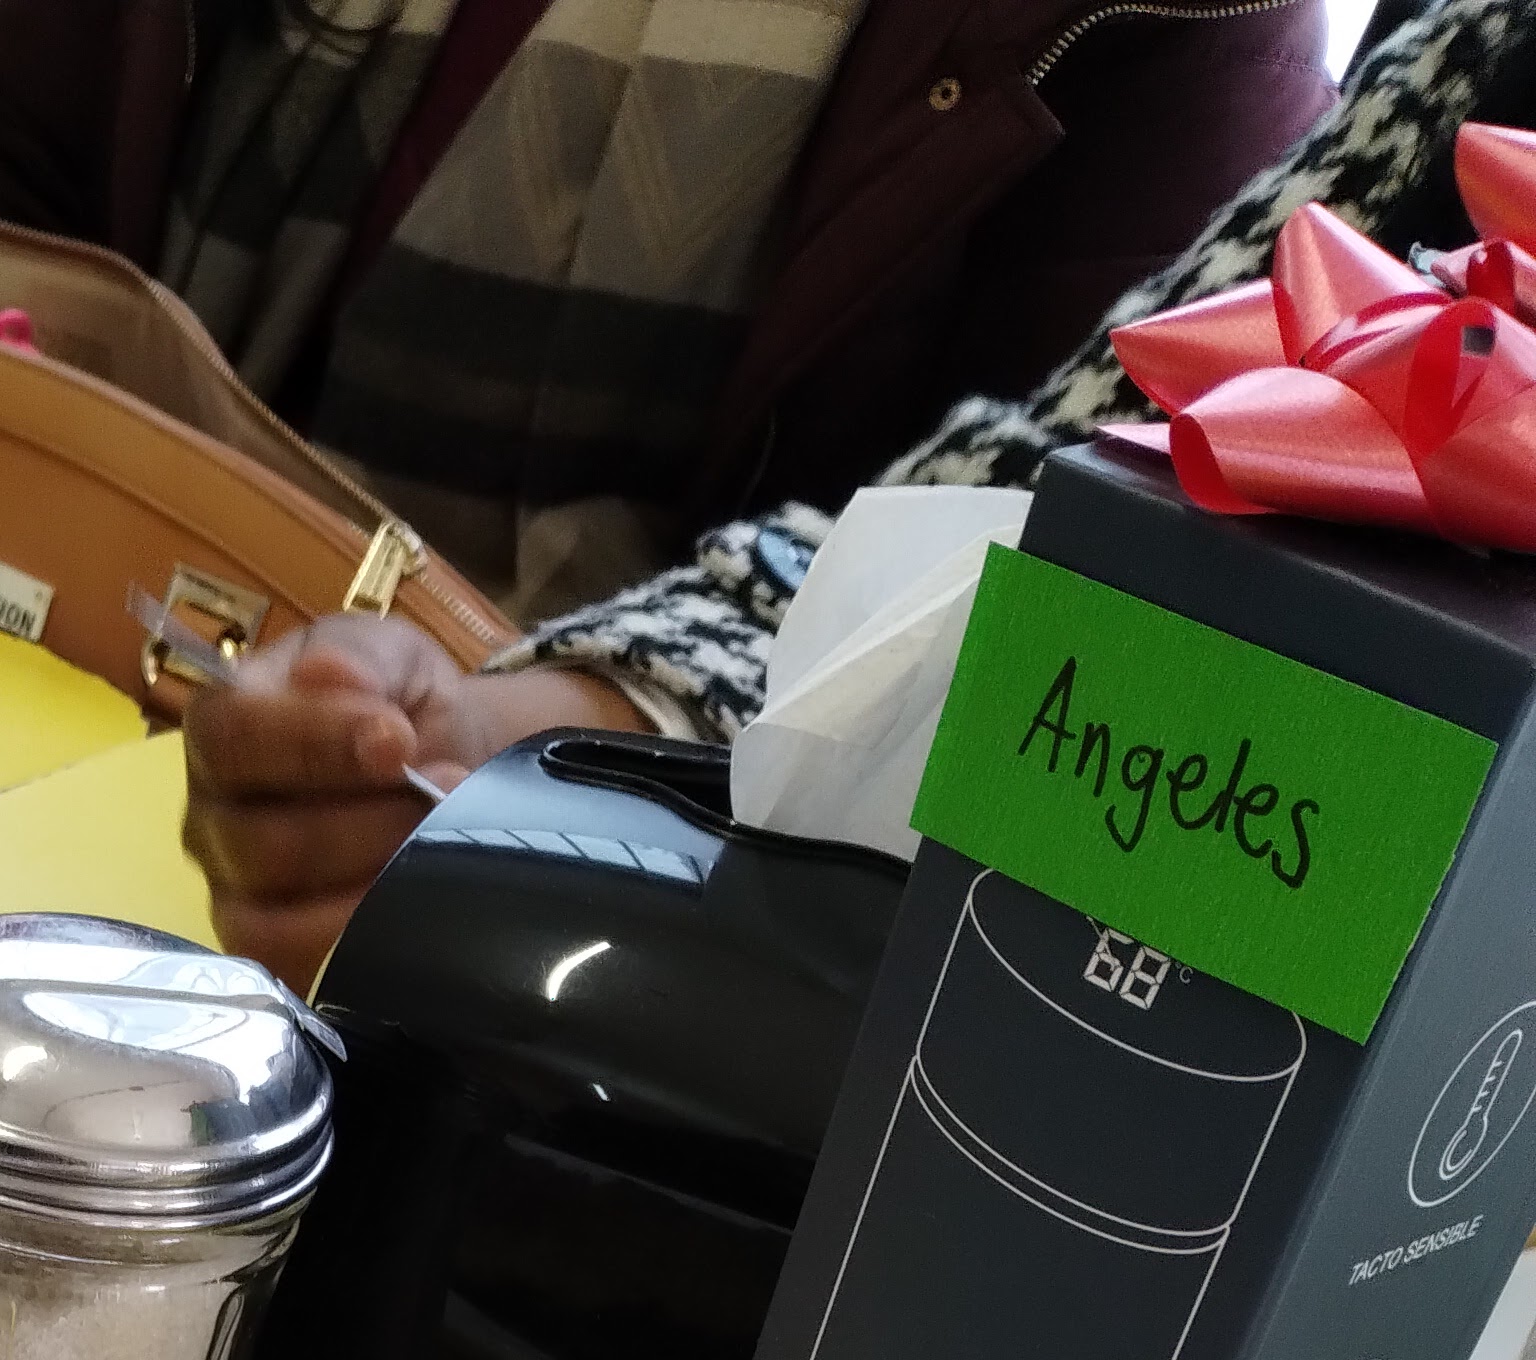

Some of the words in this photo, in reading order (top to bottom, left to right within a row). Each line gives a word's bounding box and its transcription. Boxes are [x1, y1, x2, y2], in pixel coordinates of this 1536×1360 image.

[1018, 655, 1319, 889] Angeles
[1083, 926, 1172, 1011] 68
[1348, 1246, 1404, 1286] TACTO
[1403, 1214, 1484, 1264] SENSIBLE
